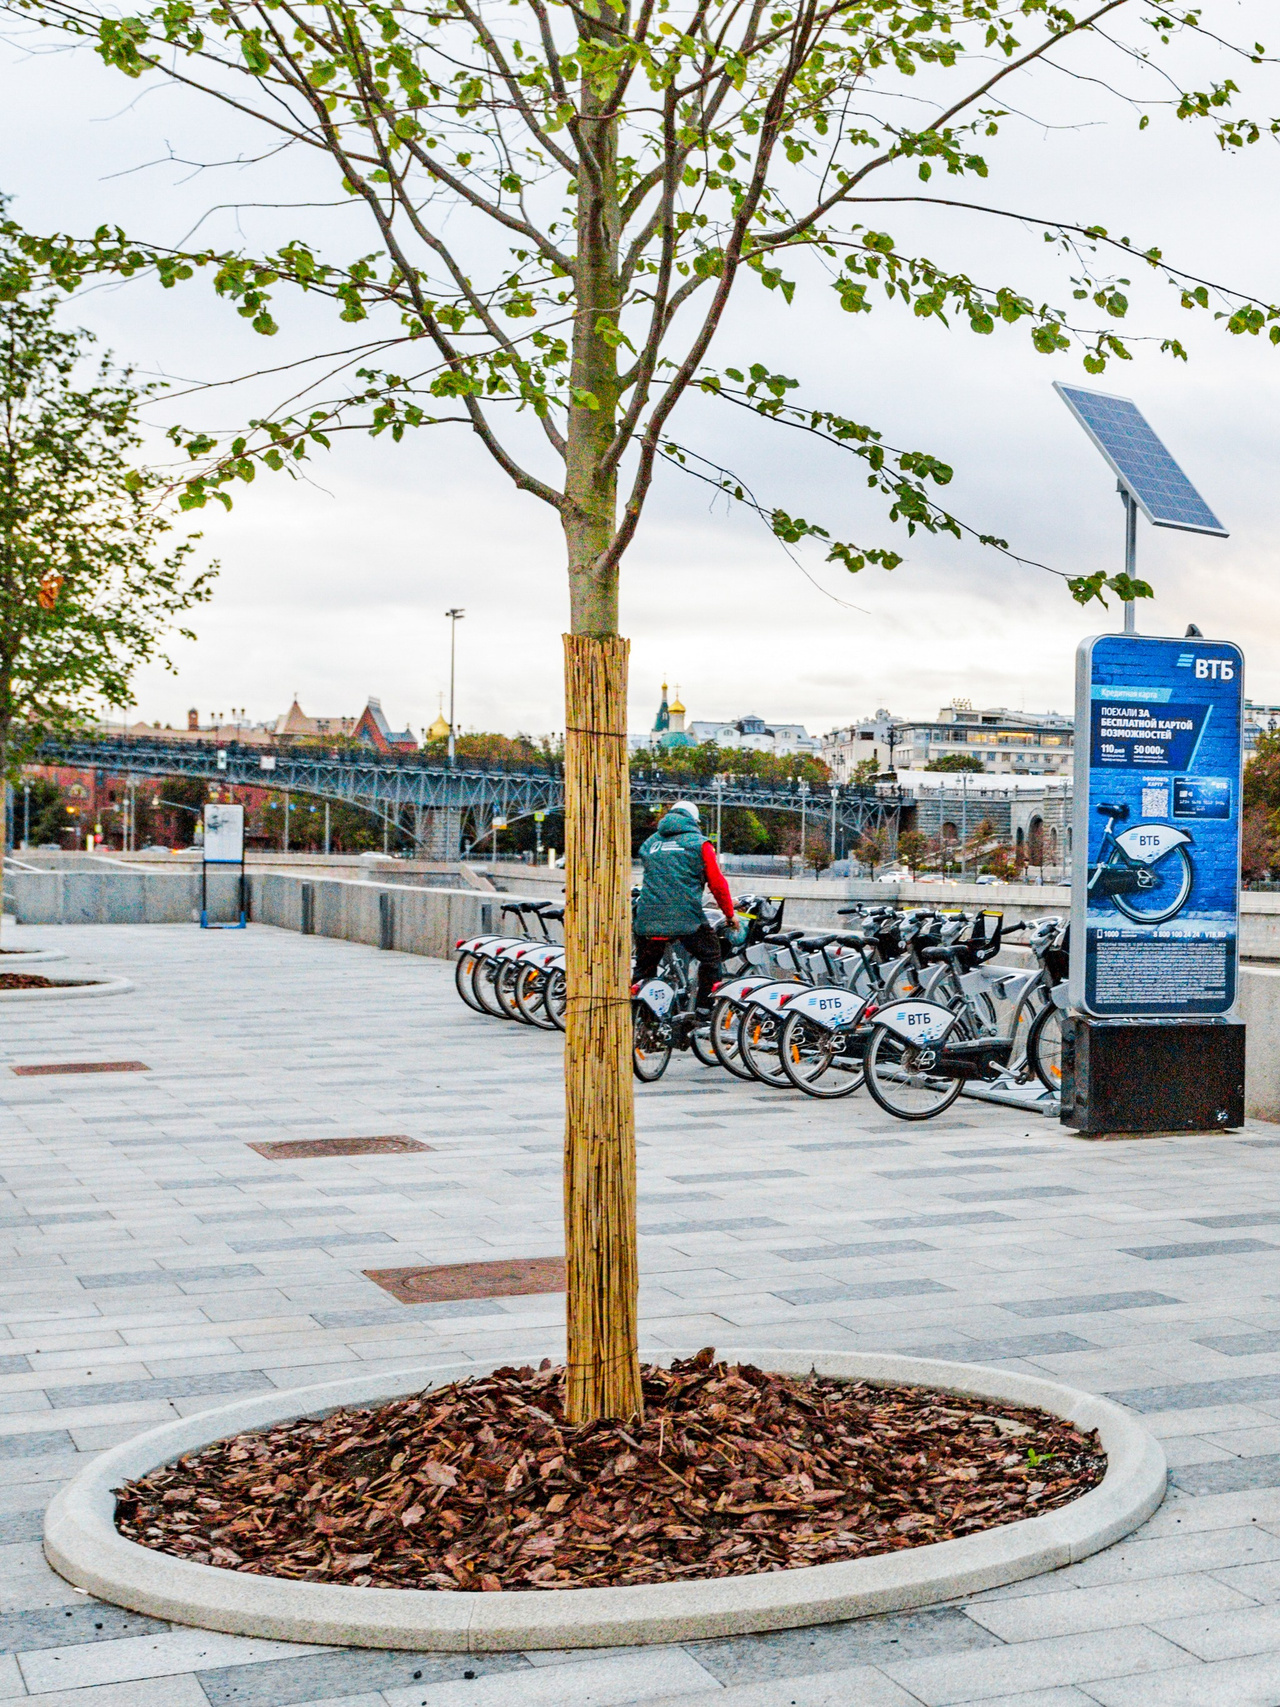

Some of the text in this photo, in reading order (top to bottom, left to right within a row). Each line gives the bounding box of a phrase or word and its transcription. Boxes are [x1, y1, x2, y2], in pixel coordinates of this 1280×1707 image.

[1195, 658, 1234, 680] ВТБ
[1101, 688, 1158, 699] Кредитная карта
[1101, 707, 1150, 718] ПОЕХАЛИ ЗА
[1101, 718, 1193, 730] БЕСПЛАТНОЙ КАРТОЙ
[1101, 728, 1172, 740] ВОЗМОЖНОСТЕЙ
[1140, 835, 1160, 846] ВТБ
[819, 997, 842, 1010] ВТБ
[907, 1013, 931, 1026] ВТБ
